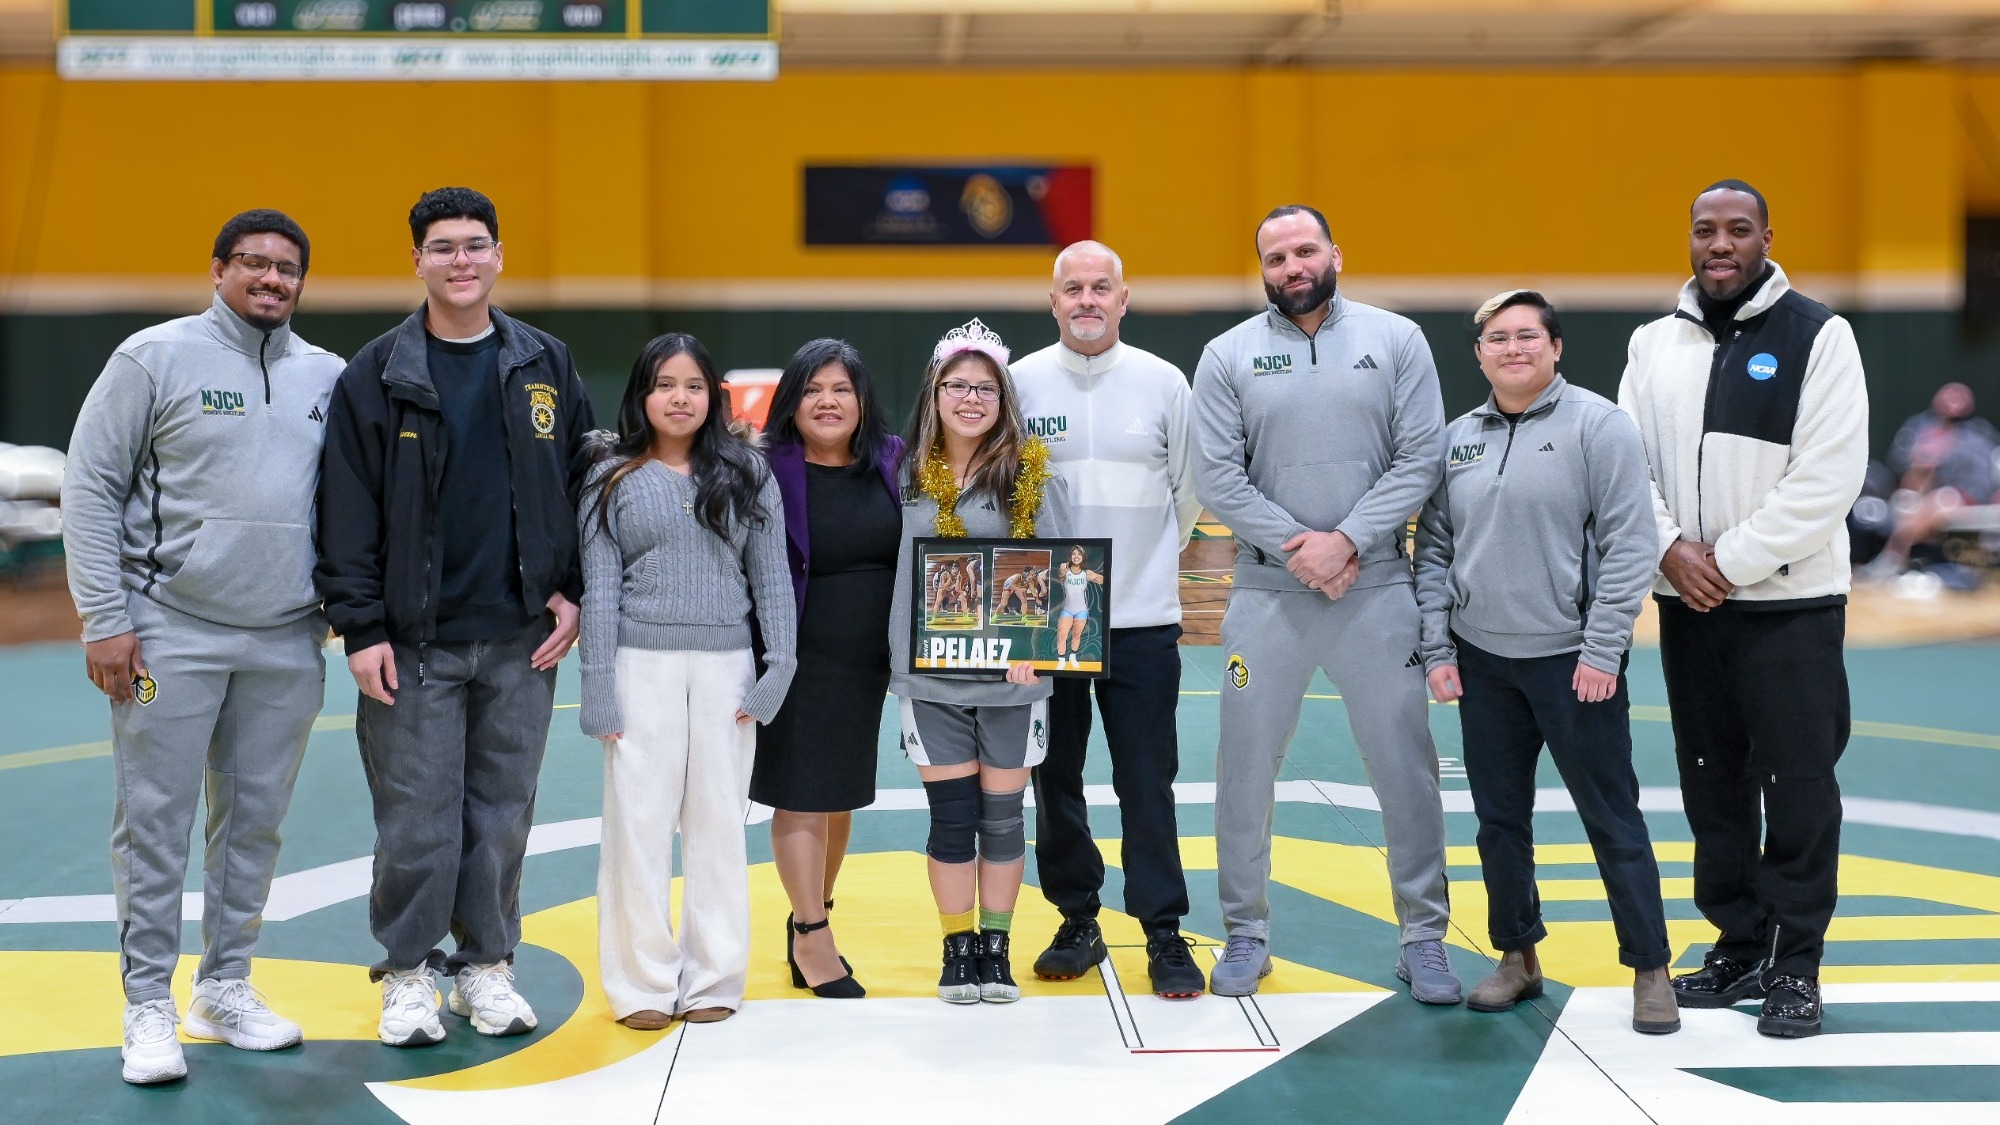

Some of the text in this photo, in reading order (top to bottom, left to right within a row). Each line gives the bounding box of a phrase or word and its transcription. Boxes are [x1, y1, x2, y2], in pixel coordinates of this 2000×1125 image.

[1254, 354, 1291, 370] NJCU
[1750, 364, 1776, 375] NCAA
[525, 383, 558, 396] TEAMSTERS
[201, 389, 244, 410] NJCU
[1027, 415, 1067, 437] NJCU
[1451, 442, 1486, 462] NJCU
[1067, 578, 1085, 586] NJCU
[930, 637, 1012, 668] PELAEZ
